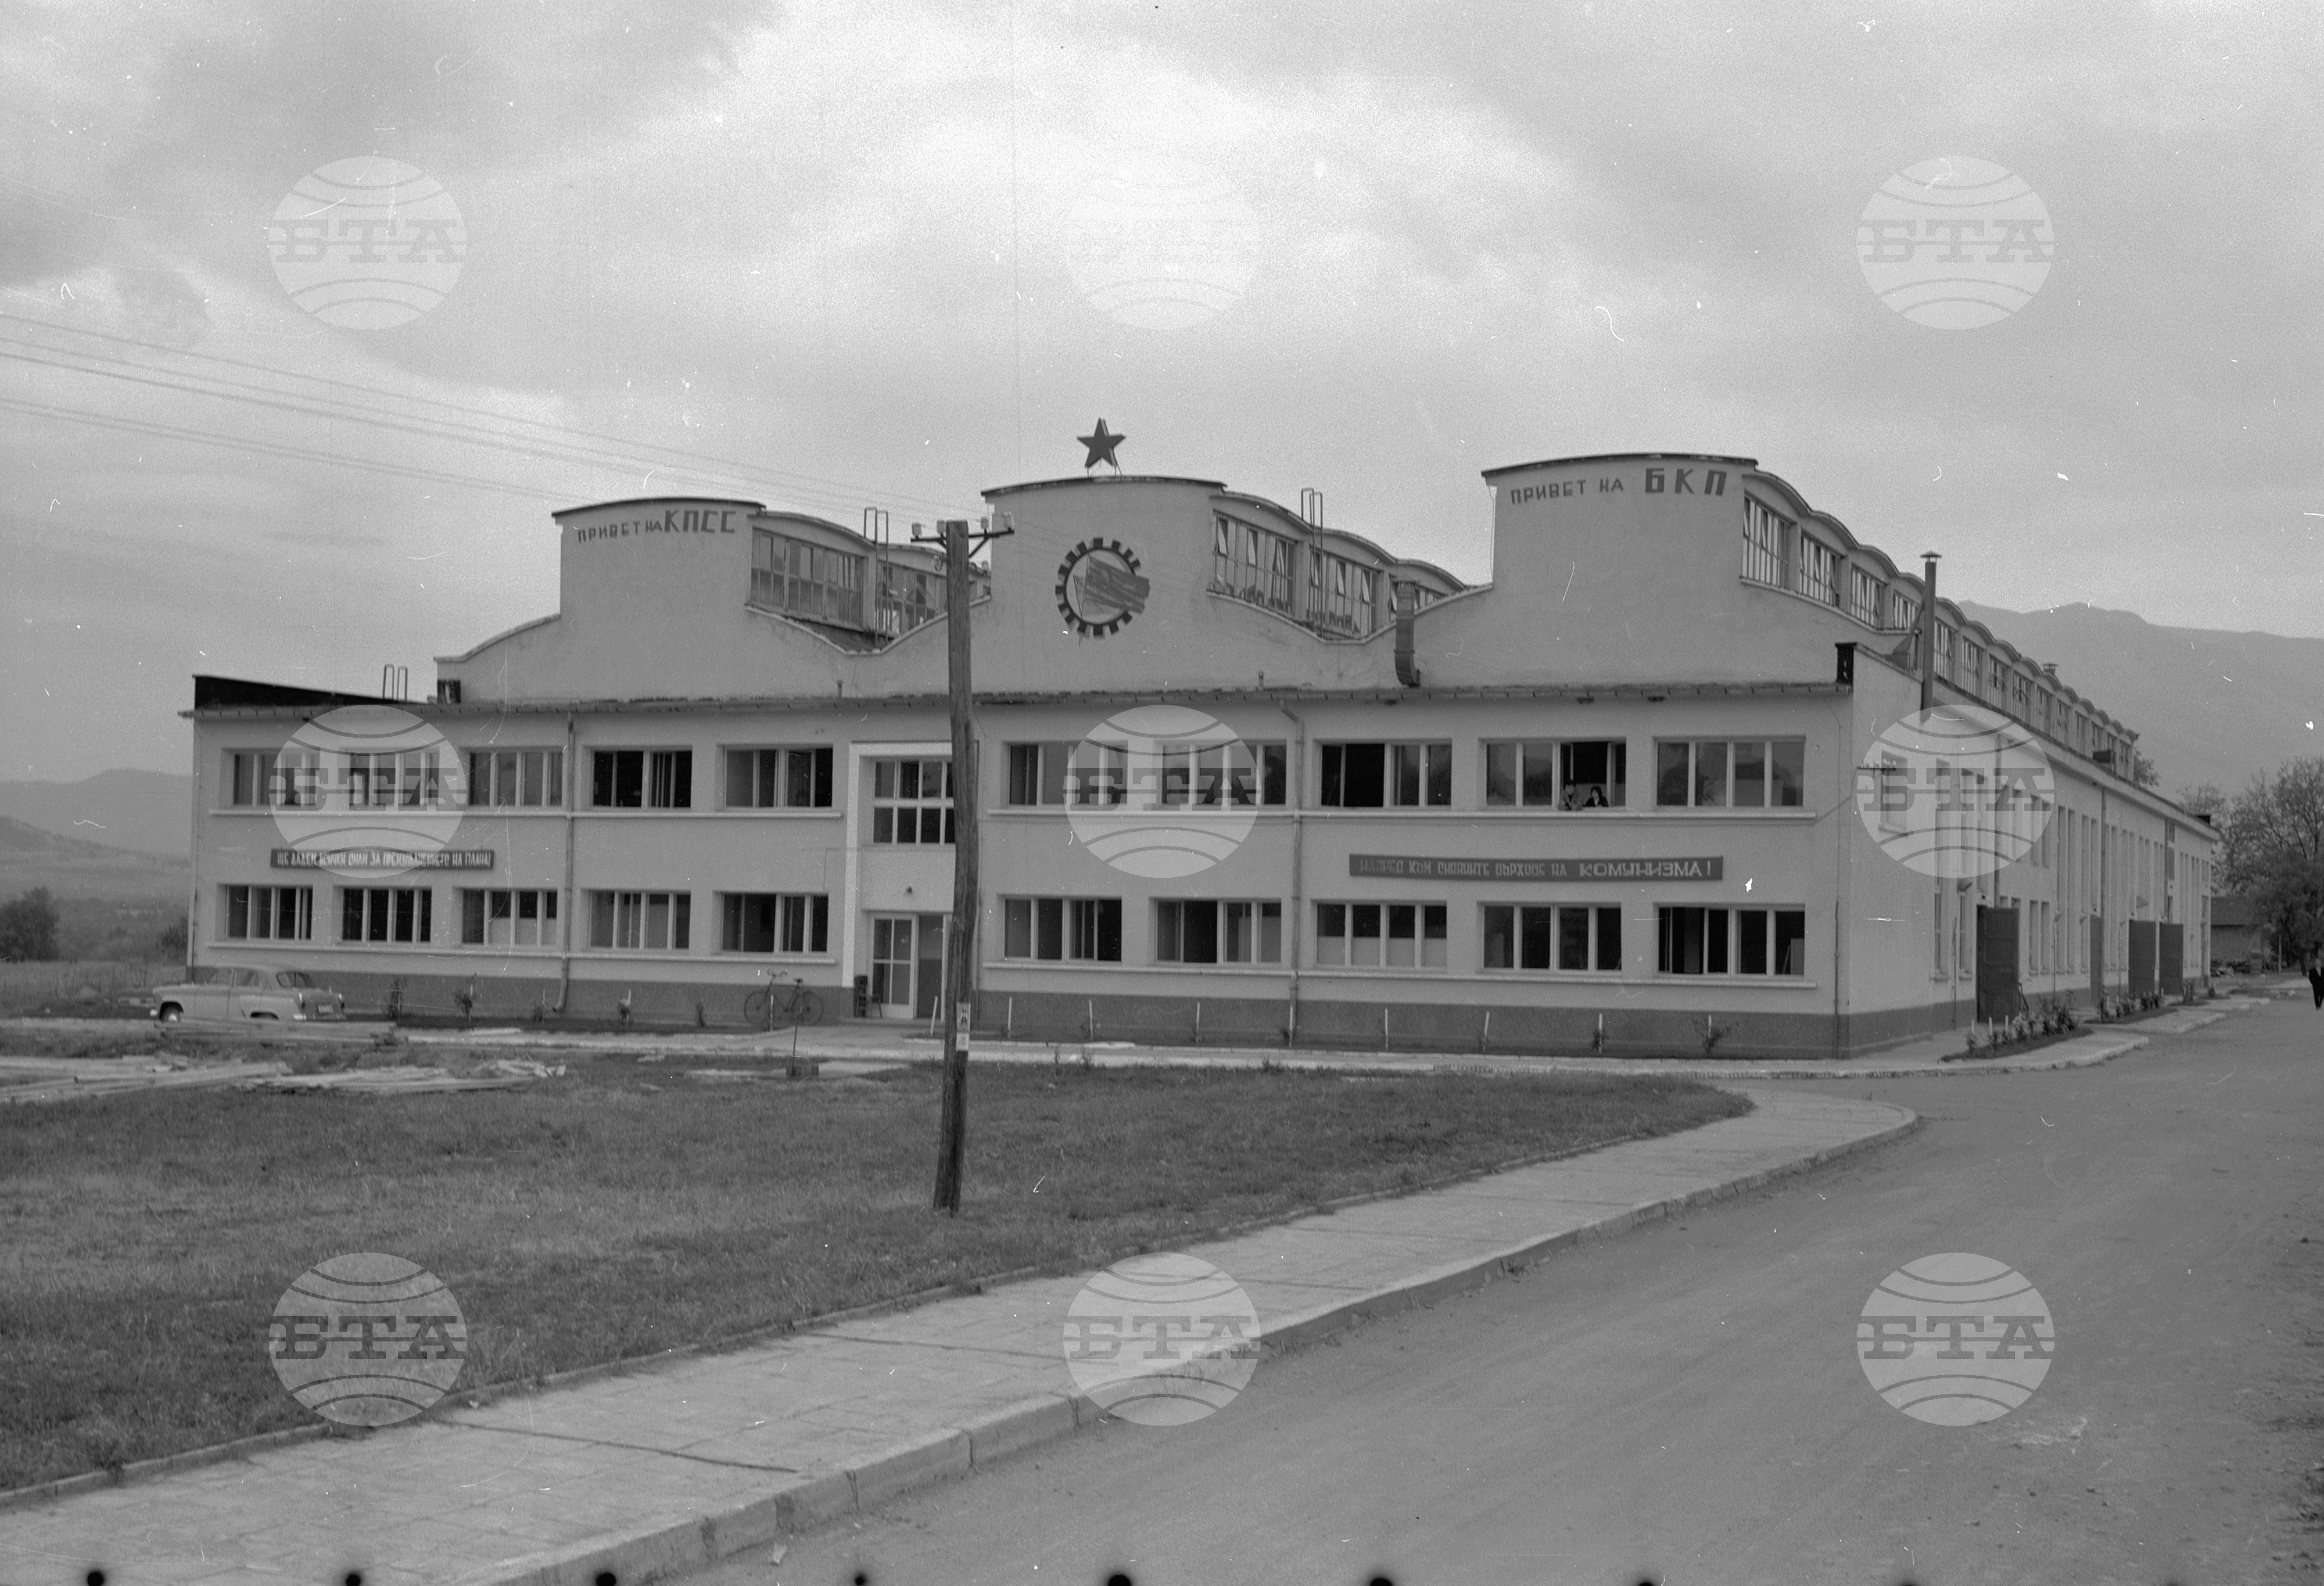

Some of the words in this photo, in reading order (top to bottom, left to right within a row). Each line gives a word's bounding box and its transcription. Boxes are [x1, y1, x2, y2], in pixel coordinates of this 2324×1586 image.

[1511, 479, 1587, 505] ПРИВЕТ
[1599, 478, 1624, 493] НА
[1645, 468, 1728, 497] БКП
[578, 521, 641, 544] ПРИВЕТ
[645, 520, 663, 533] НА
[664, 509, 737, 534] КПСС
[370, 851, 381, 866] ЗА
[452, 852, 462, 867] НА
[1409, 860, 1432, 875] КЪМ
[1551, 863, 1568, 877] НА
